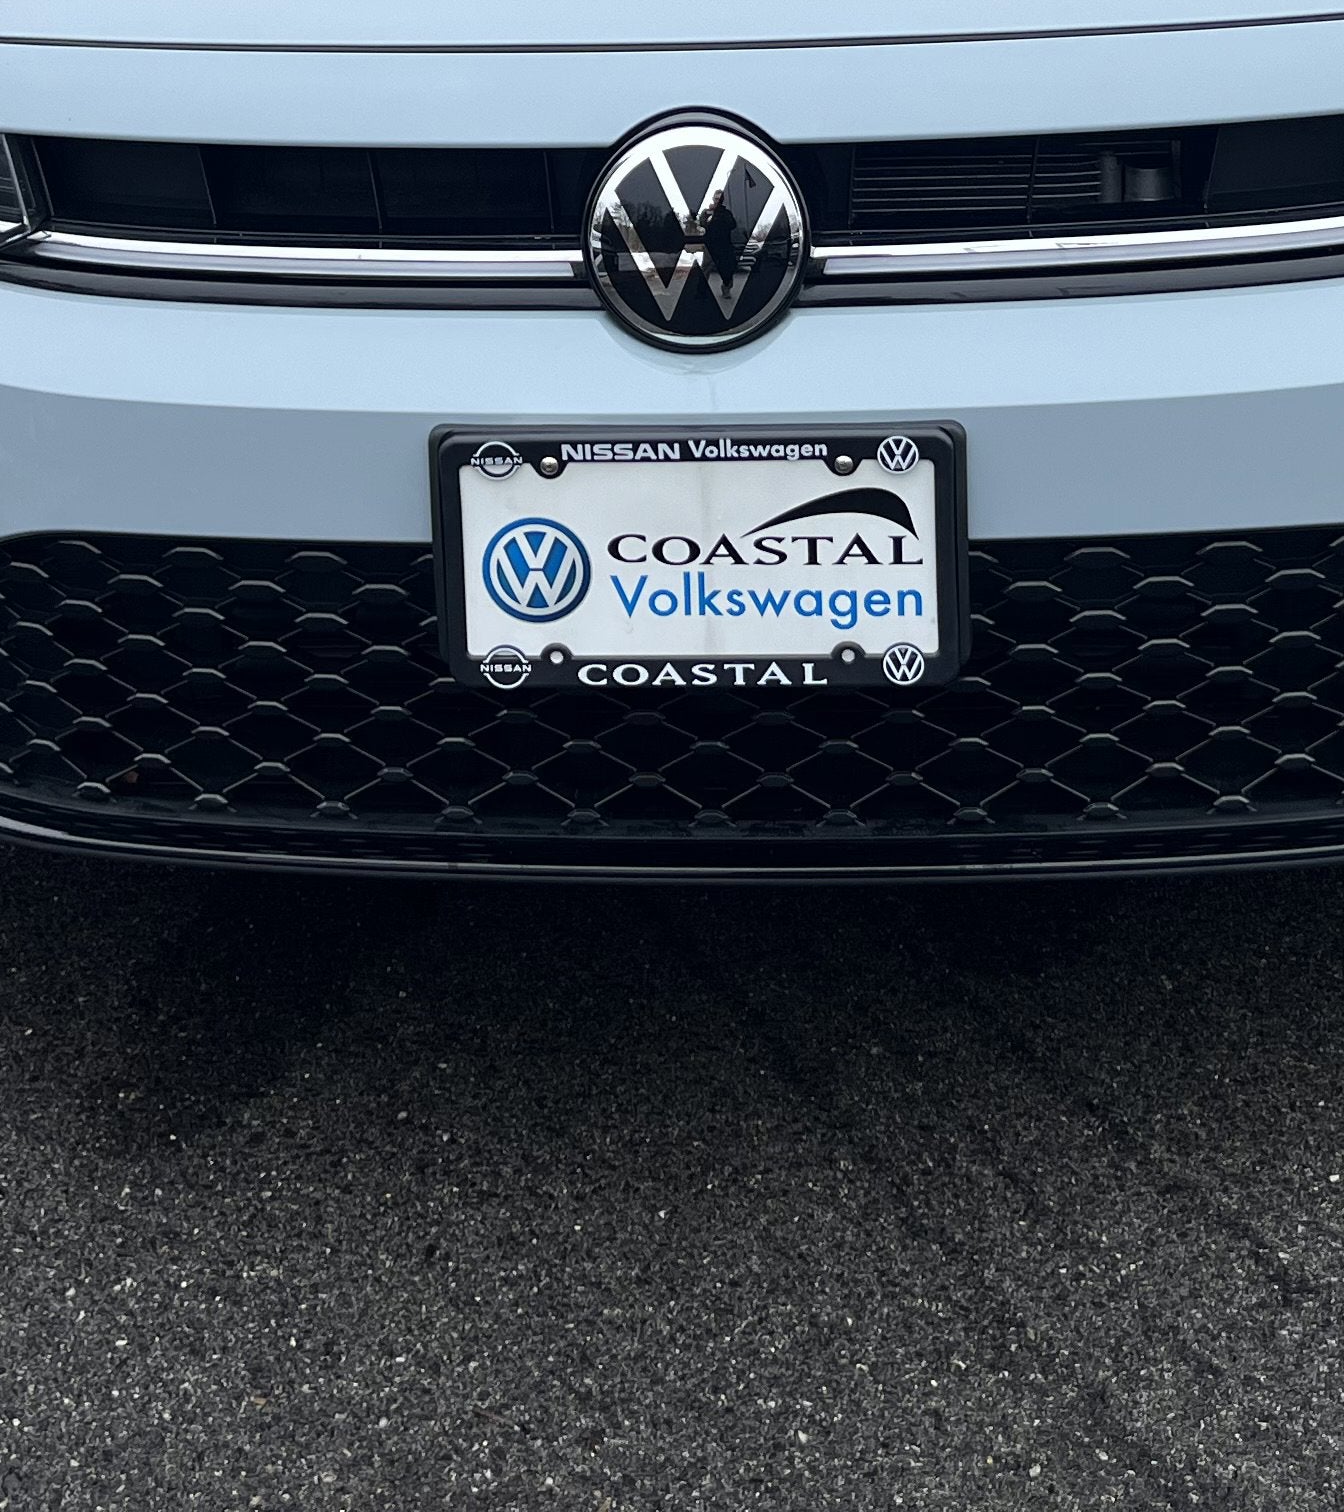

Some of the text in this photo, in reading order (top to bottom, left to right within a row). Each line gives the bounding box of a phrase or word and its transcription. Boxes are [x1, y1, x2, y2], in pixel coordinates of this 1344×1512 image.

[470, 456, 523, 466] NISSAN
[562, 439, 828, 462] NISSAN Volkswagen
[607, 533, 924, 566] COASTAL
[610, 571, 923, 630] Volkswagen
[480, 663, 532, 673] NISSAN
[578, 662, 828, 687] COASTAL
